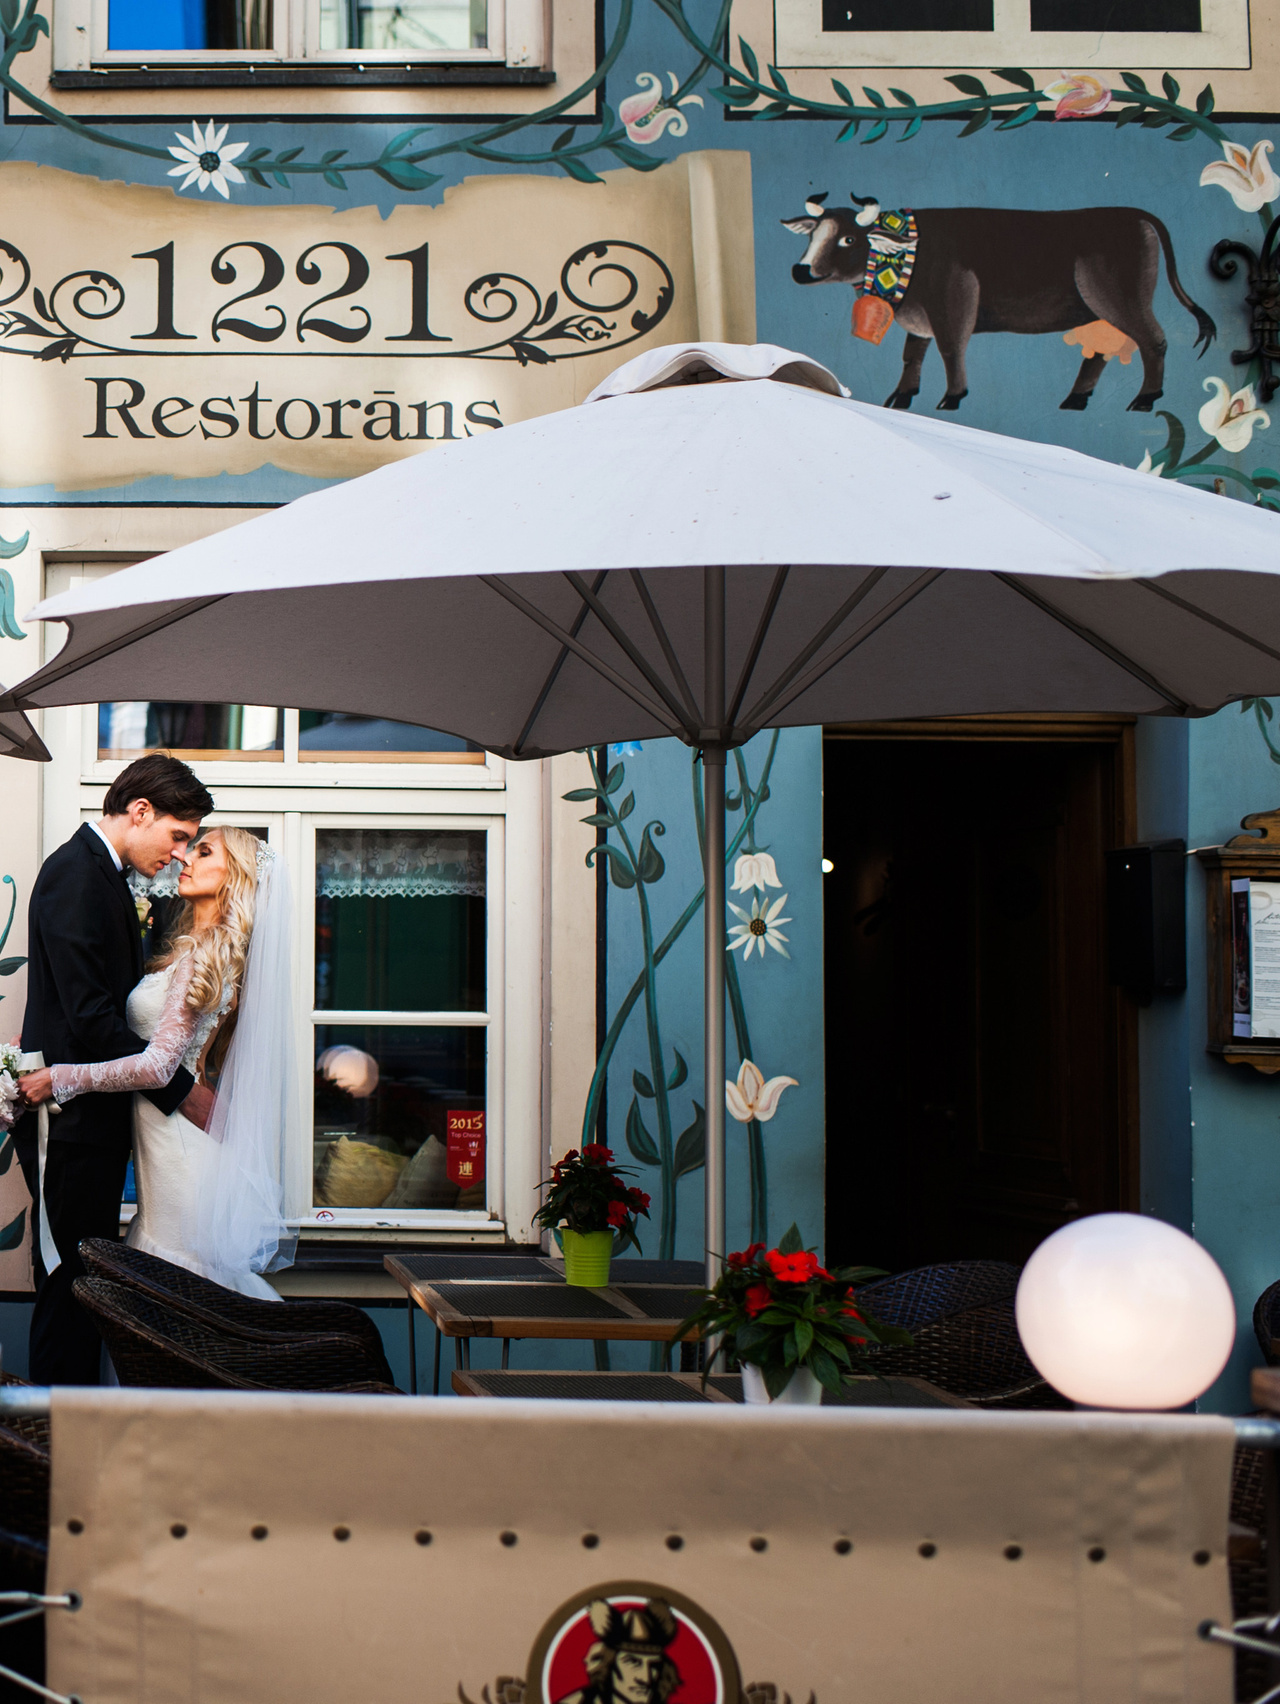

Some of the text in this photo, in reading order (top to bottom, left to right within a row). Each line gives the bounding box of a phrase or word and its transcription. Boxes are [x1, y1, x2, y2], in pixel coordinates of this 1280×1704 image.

[130, 240, 453, 343] 1221
[83, 377, 504, 440] Restorāns
[450, 1113, 483, 1130] 2015
